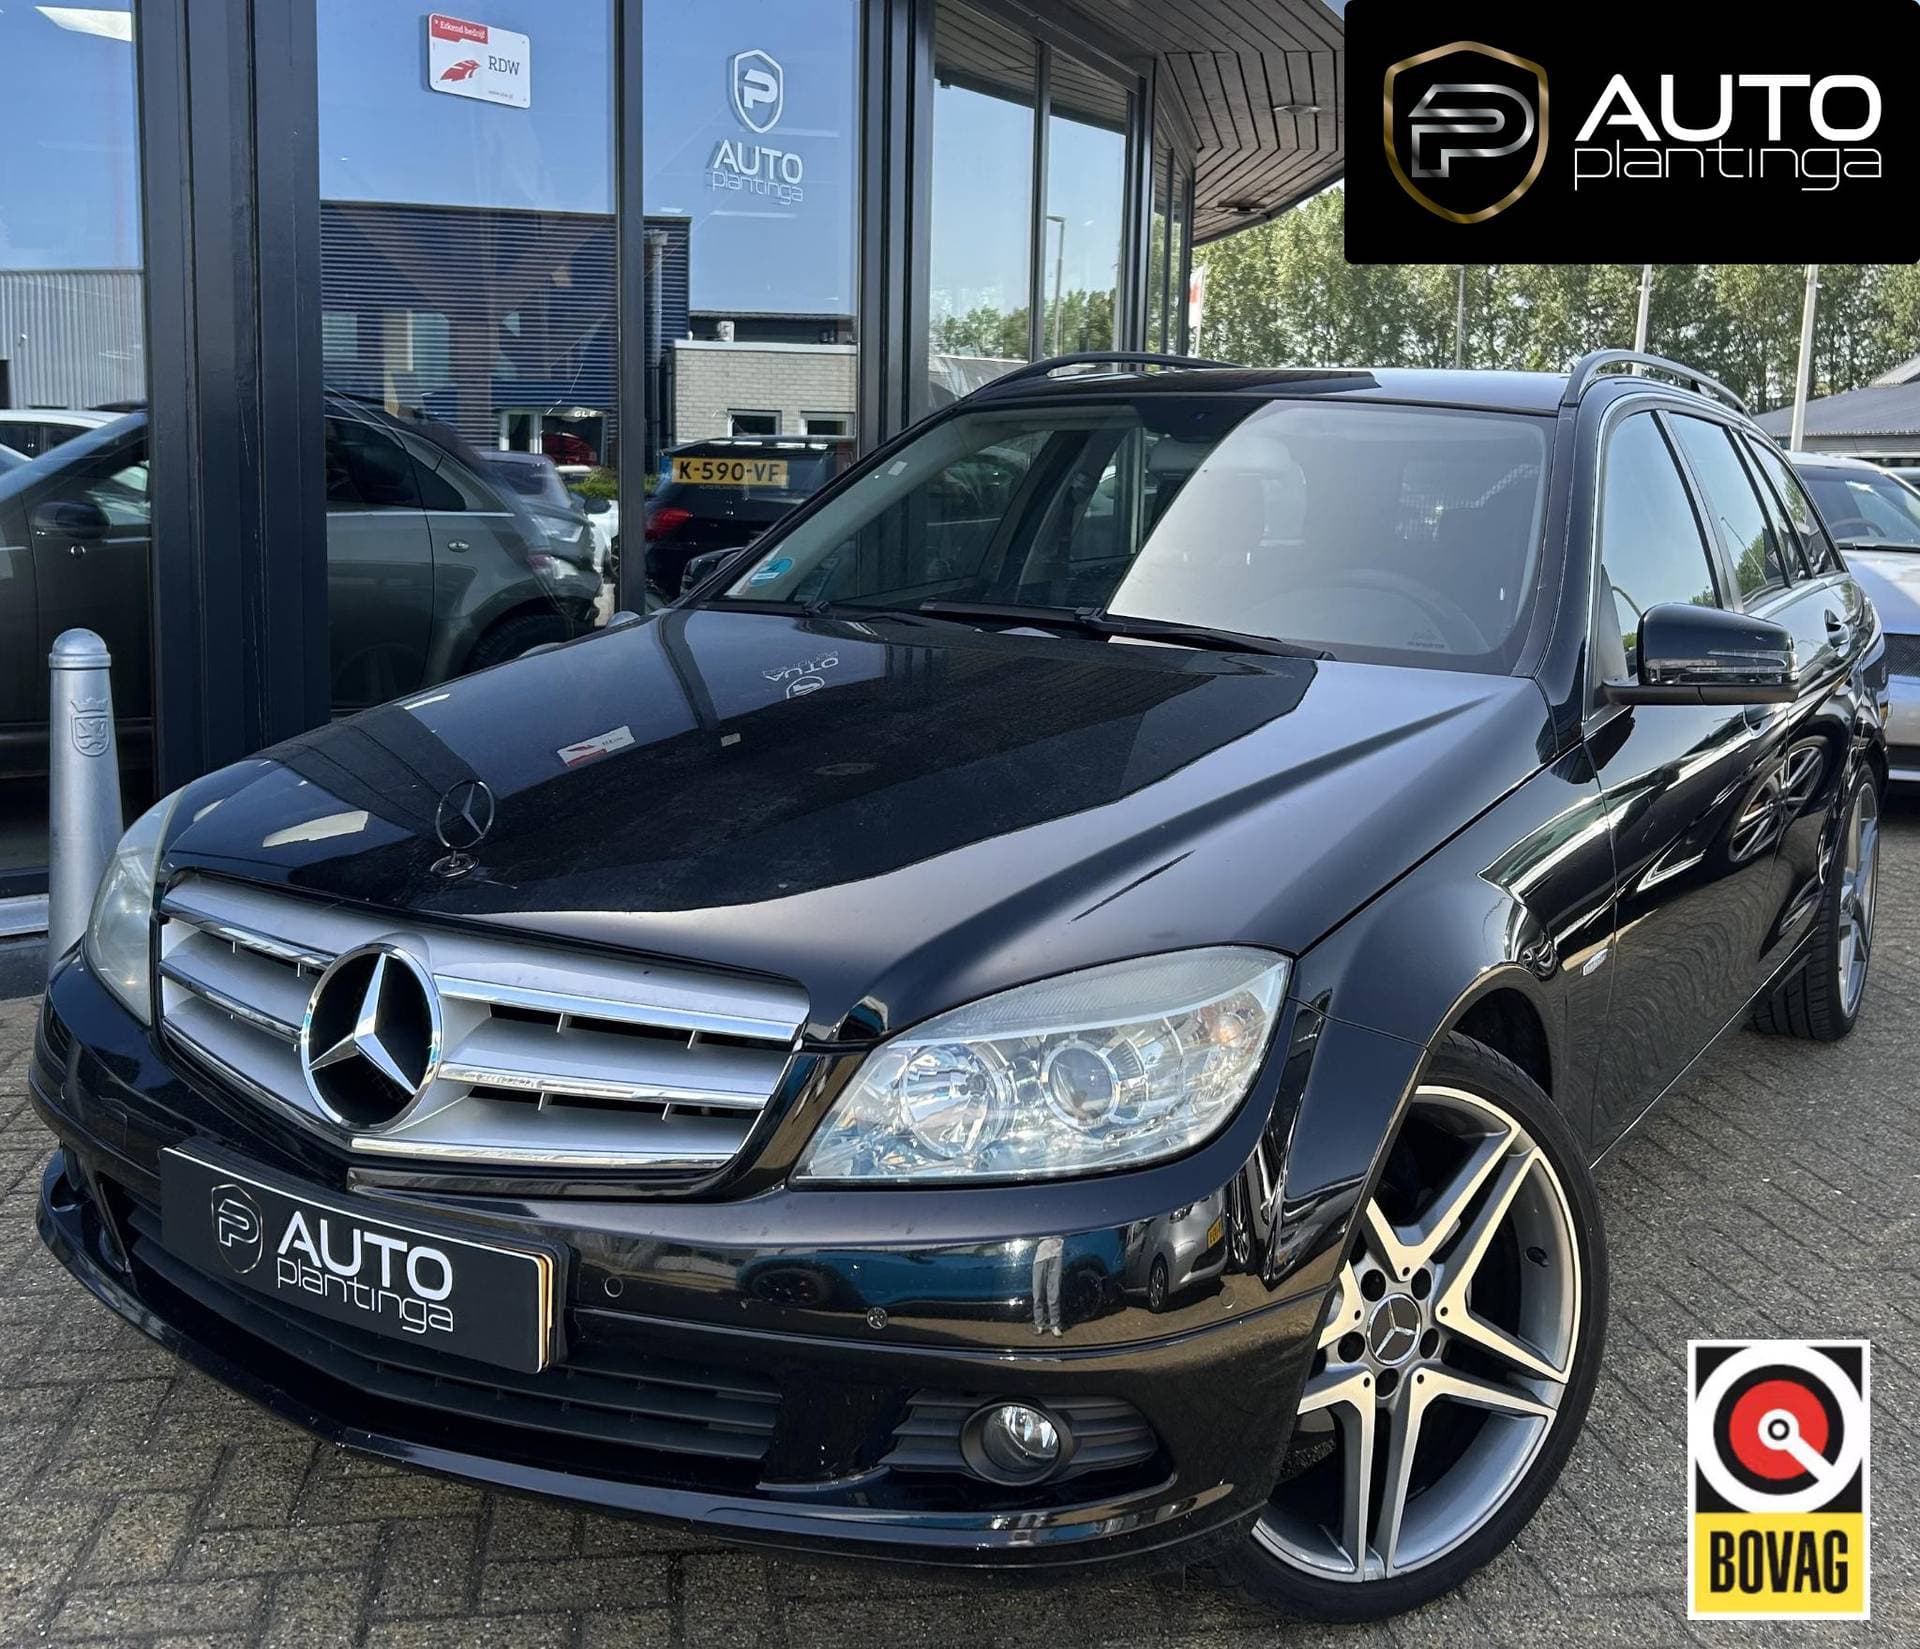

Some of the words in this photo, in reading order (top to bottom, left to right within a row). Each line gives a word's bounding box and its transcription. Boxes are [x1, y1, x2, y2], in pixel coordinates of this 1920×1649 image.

[488, 55, 520, 76] RDW
[713, 139, 804, 185] AUTO
[712, 170, 804, 205] plantinga
[679, 461, 781, 483] K-590-VF
[277, 1210, 453, 1300] AUTO
[277, 1257, 454, 1335] plantinga
